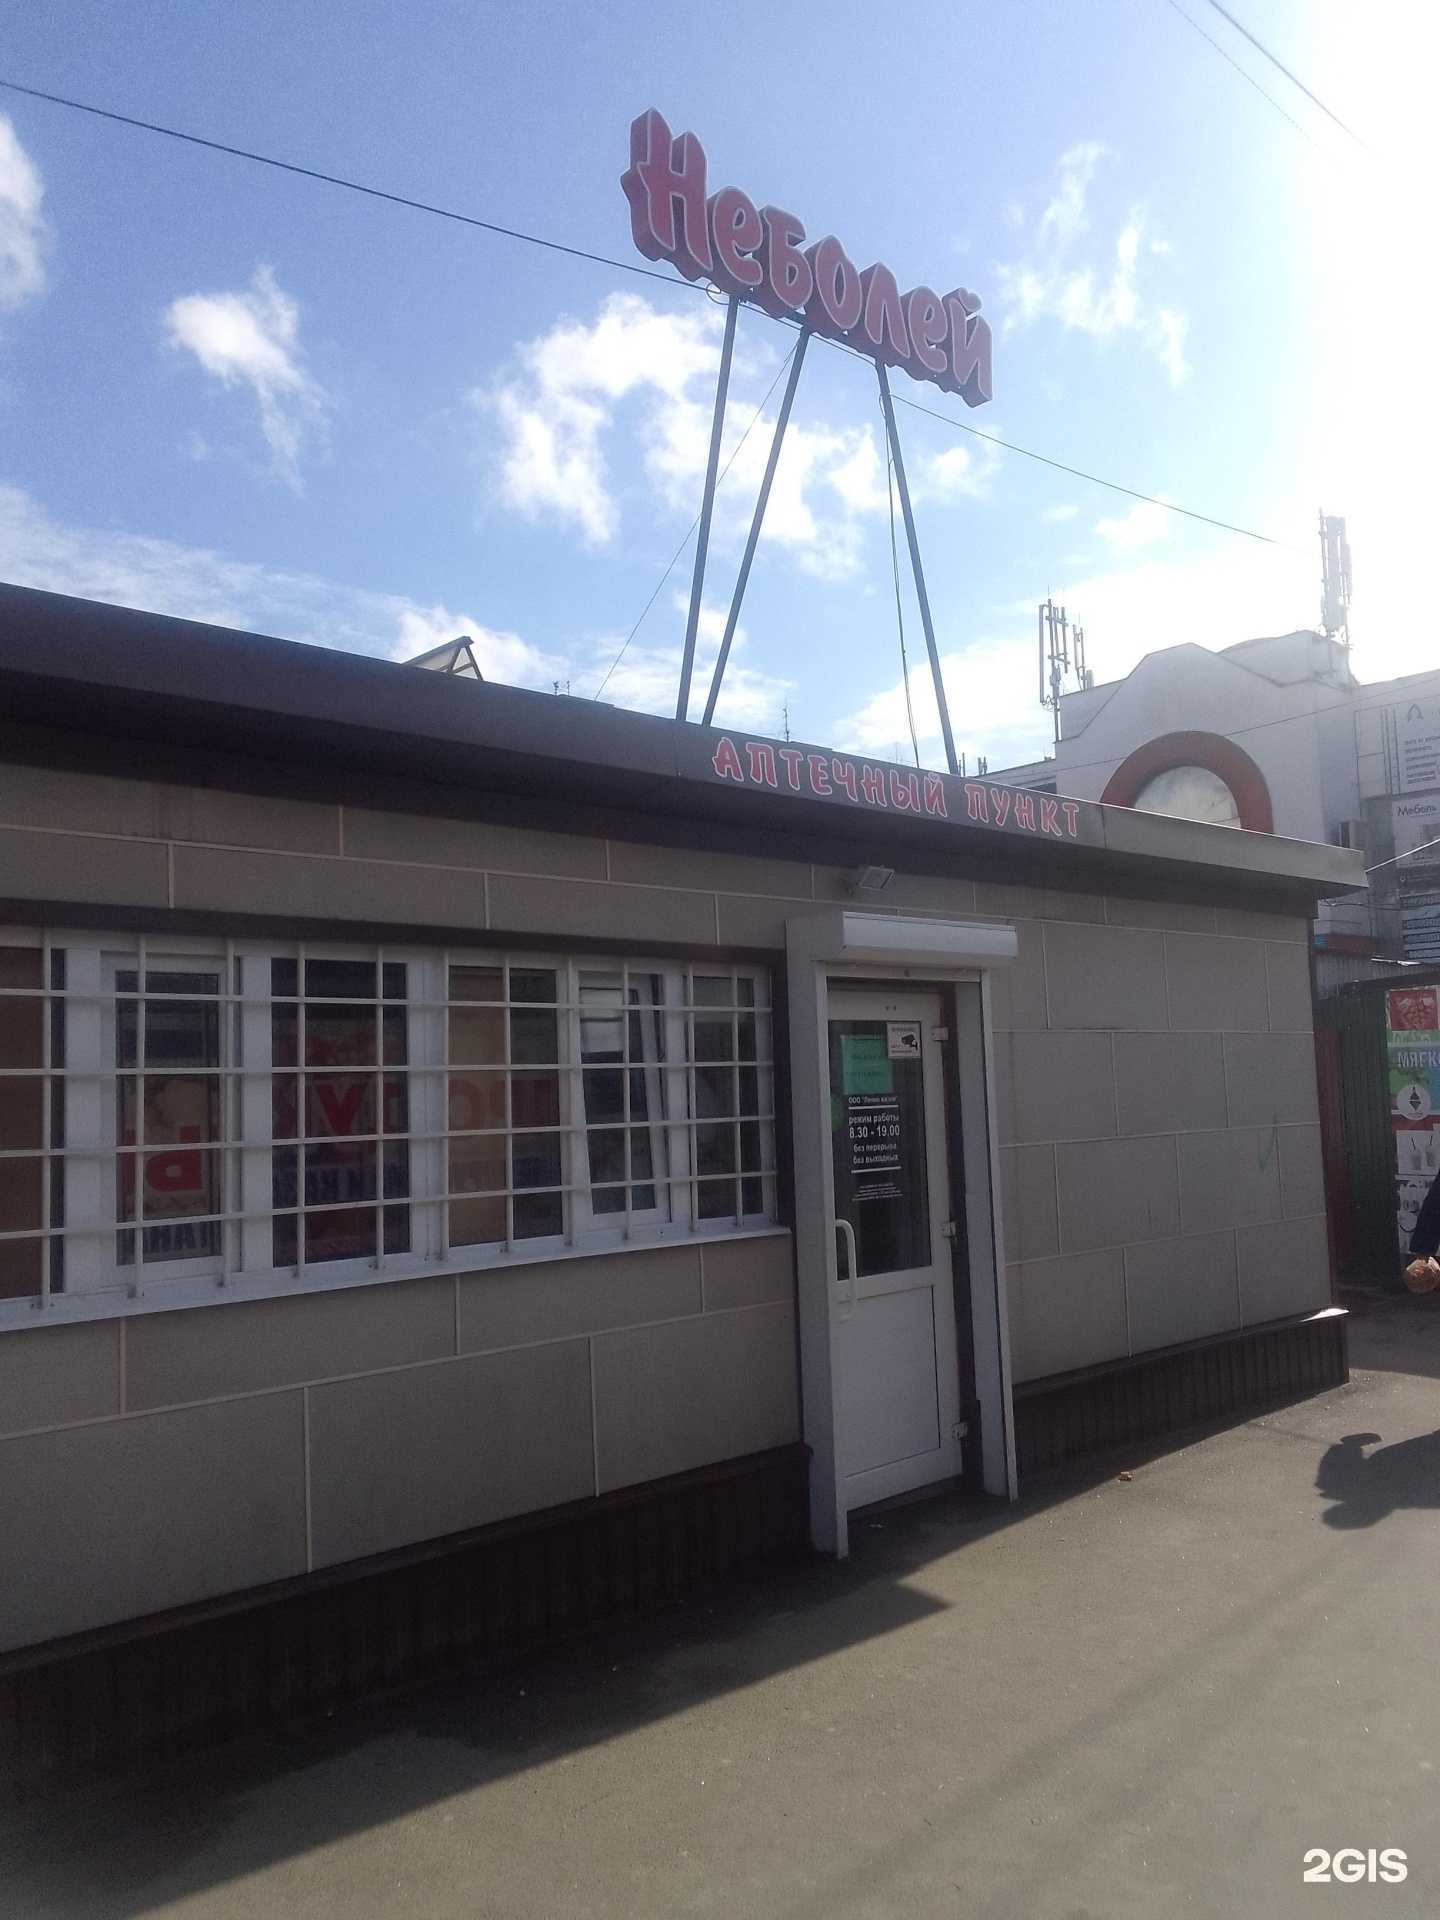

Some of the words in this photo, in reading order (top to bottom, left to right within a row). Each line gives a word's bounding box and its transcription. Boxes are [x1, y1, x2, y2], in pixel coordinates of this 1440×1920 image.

[620, 107, 993, 408] Неболей
[712, 737, 948, 818] АПТЕЧНЫЙ
[964, 783, 1080, 837] ПУНКТ
[849, 1126, 868, 1139] 8.30
[876, 1124, 901, 1137] 19.00
